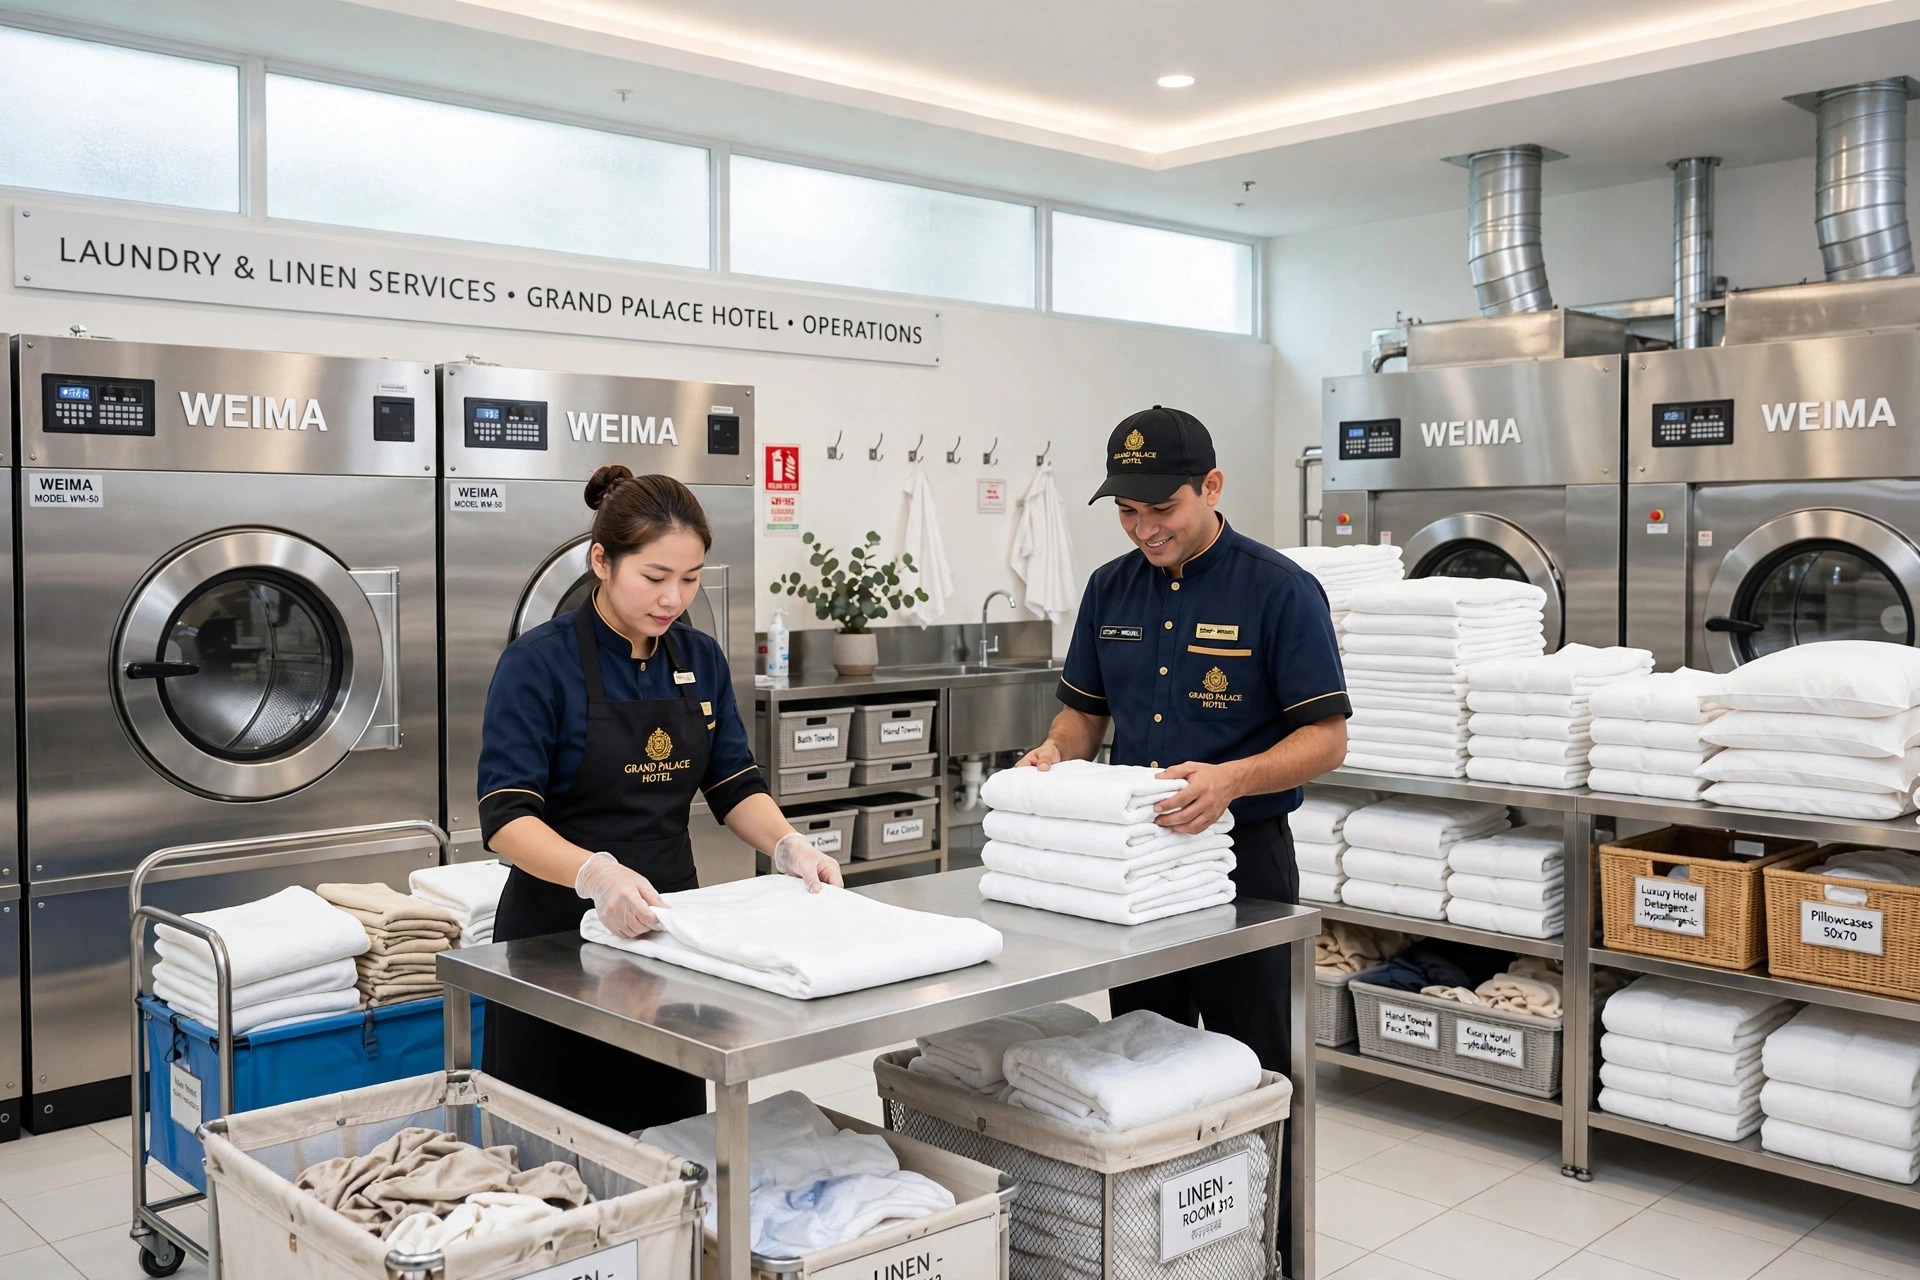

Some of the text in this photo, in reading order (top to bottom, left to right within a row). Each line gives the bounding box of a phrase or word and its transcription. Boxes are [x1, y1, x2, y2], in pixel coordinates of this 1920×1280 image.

[60, 237, 923, 345] LAUNDRY & LINEN SERVICES GRAND PALACE HOTEL OPERATIONS
[179, 391, 328, 432] WEIMA
[1760, 397, 1897, 433] WEIMA
[566, 411, 679, 446] WEIMA
[1421, 418, 1522, 448] WEIMA
[40, 478, 93, 491] WEIMA
[458, 487, 499, 498] WEIMA
[34, 494, 67, 503] MODEL
[1188, 691, 1243, 701] GRAND PALACE
[624, 759, 691, 773] GRAND PALACE
[642, 772, 672, 783] HOTEL
[1641, 884, 1698, 902] Luxury Hotel
[1811, 910, 1874, 929] Pillowcases
[1824, 927, 1857, 942] 50x70
[1385, 1010, 1406, 1022] Hand
[1179, 1175, 1223, 1209] LINEN
[1183, 1201, 1216, 1227] ROOM
